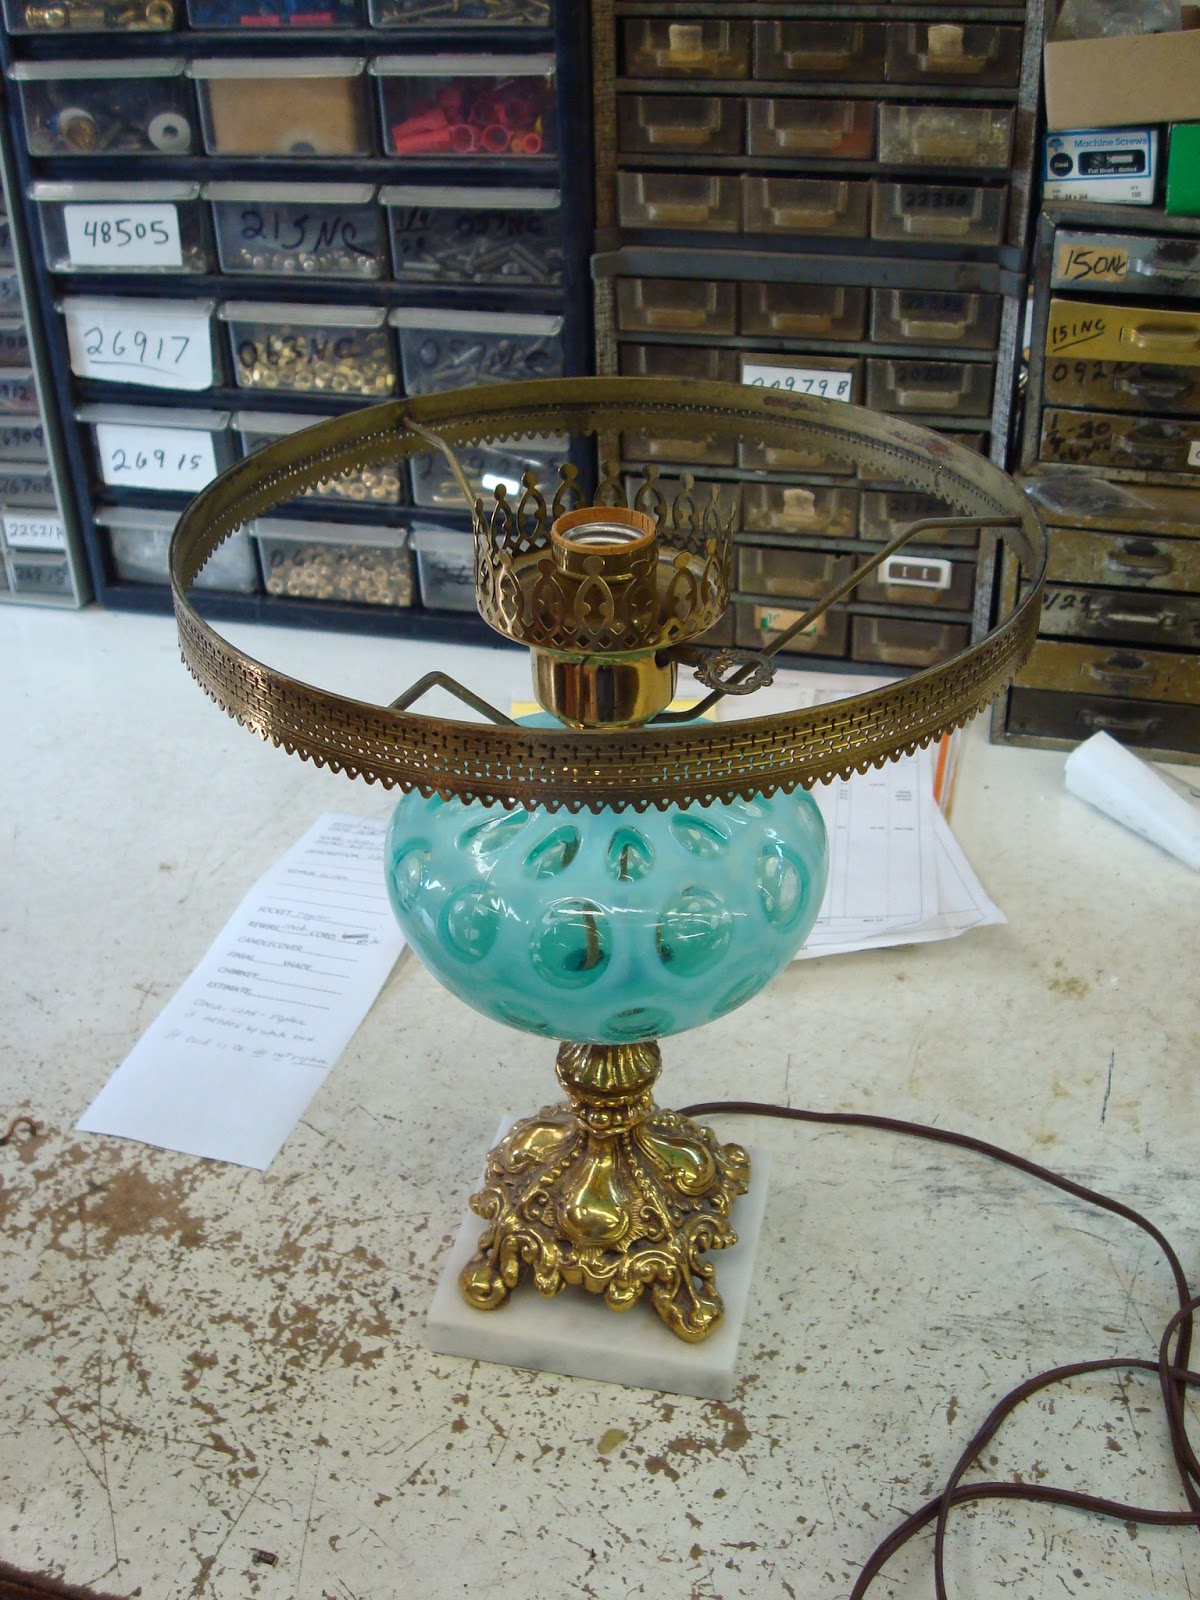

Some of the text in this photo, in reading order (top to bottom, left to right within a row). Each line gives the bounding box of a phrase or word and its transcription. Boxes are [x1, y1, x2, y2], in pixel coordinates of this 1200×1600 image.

[1074, 136, 1147, 149] Machine Screws
[84, 218, 169, 247] 48505
[84, 326, 190, 364] 26917
